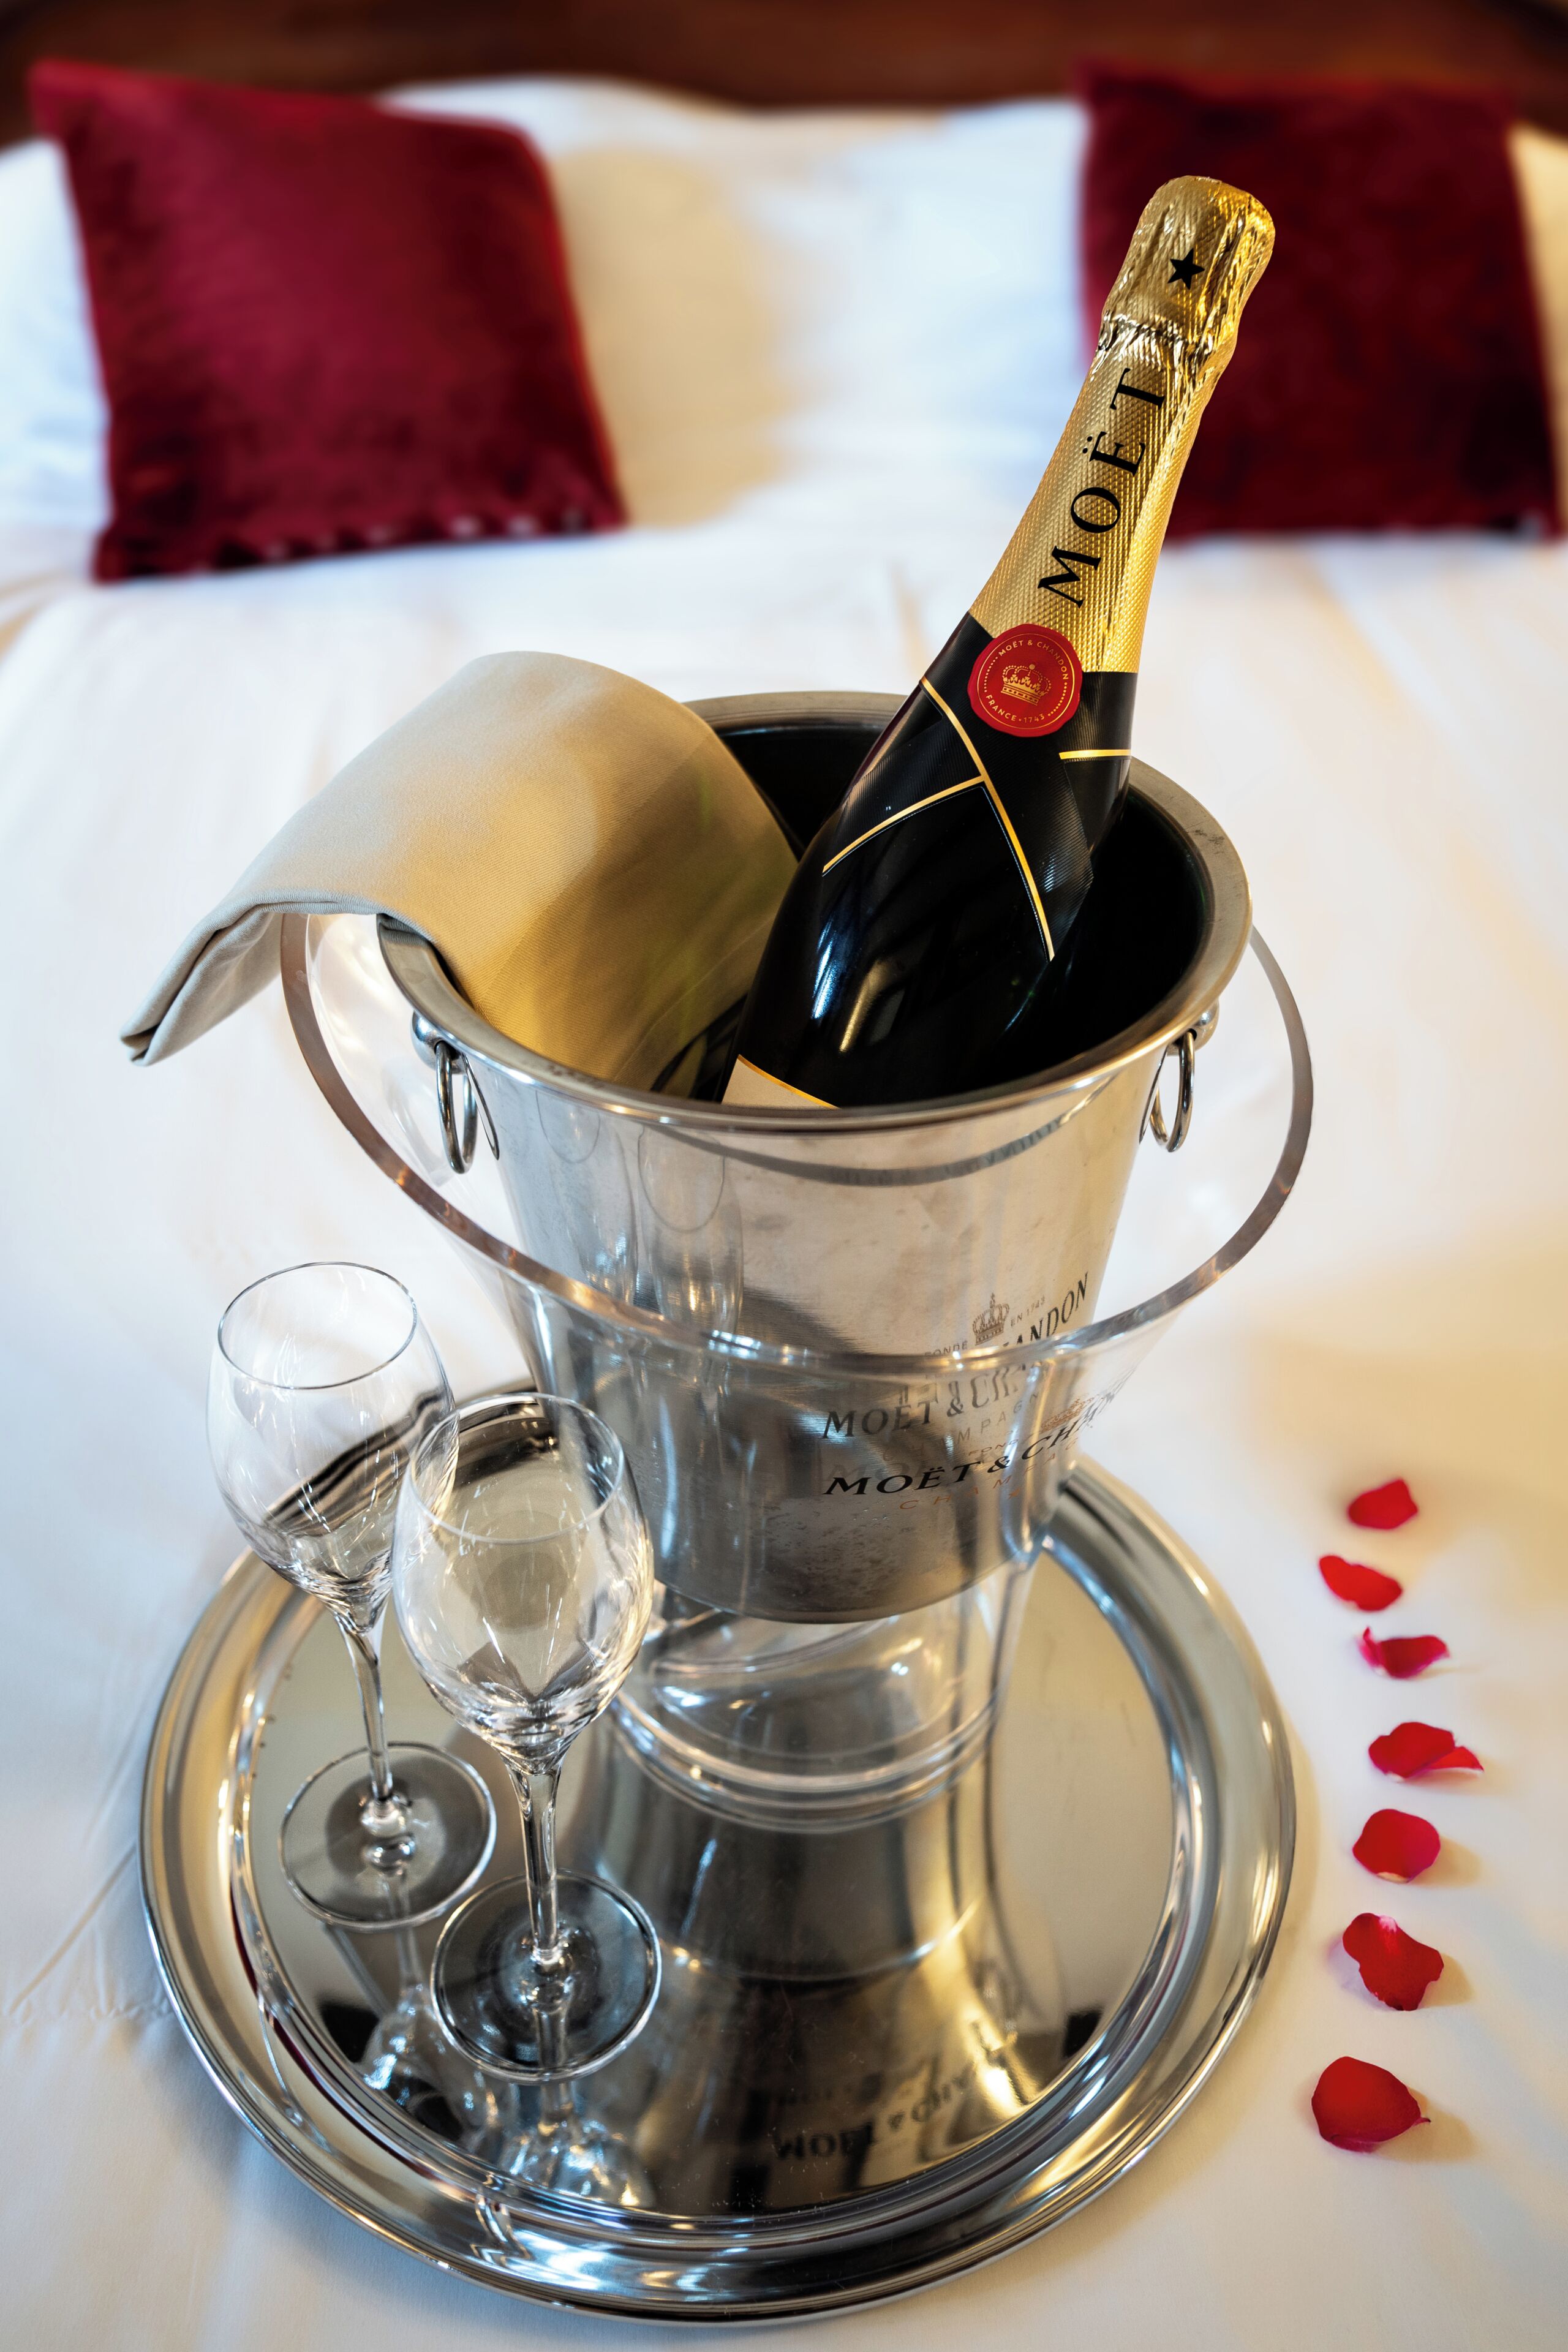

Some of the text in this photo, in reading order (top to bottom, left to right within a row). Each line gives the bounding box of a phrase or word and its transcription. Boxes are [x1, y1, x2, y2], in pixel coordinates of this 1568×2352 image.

[1037, 368, 1164, 608] MOËT
[998, 639, 1024, 657] MOËT
[1036, 641, 1069, 680] CHANDON
[985, 694, 1045, 723] FRANCE 1743
[822, 1461, 981, 1495] MOËT
[987, 1455, 1012, 1474] &
